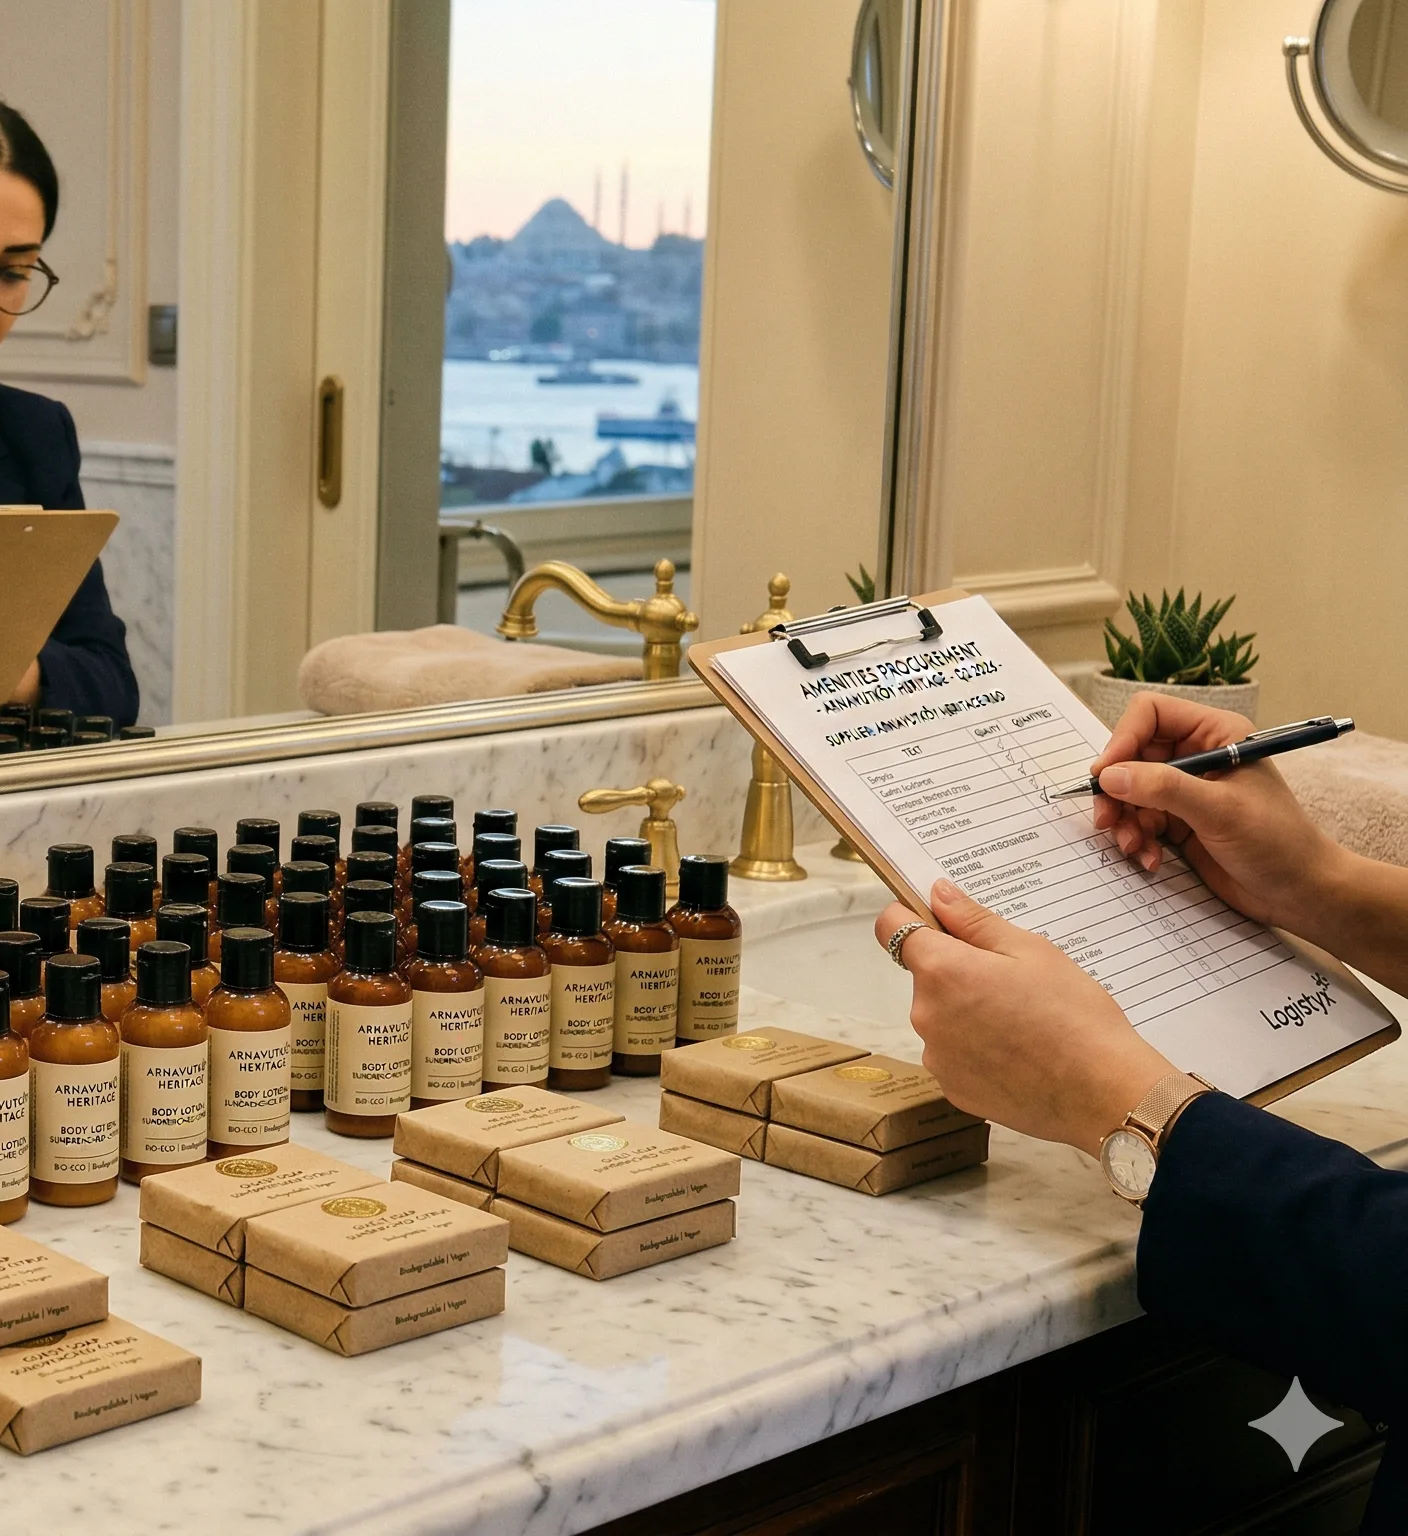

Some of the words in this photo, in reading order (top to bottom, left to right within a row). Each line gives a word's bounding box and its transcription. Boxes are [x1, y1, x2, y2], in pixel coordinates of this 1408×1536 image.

[800, 667, 879, 700] AMENITIES
[876, 642, 982, 680] PROCUREMENT
[1259, 991, 1337, 1030] Logistyx
[504, 1032, 528, 1040] BODY
[67, 1091, 116, 1107] HERITAGE
[152, 1107, 179, 1117] BODY
[60, 1126, 88, 1135] BODY
[47, 1305, 70, 1316] Vegan
